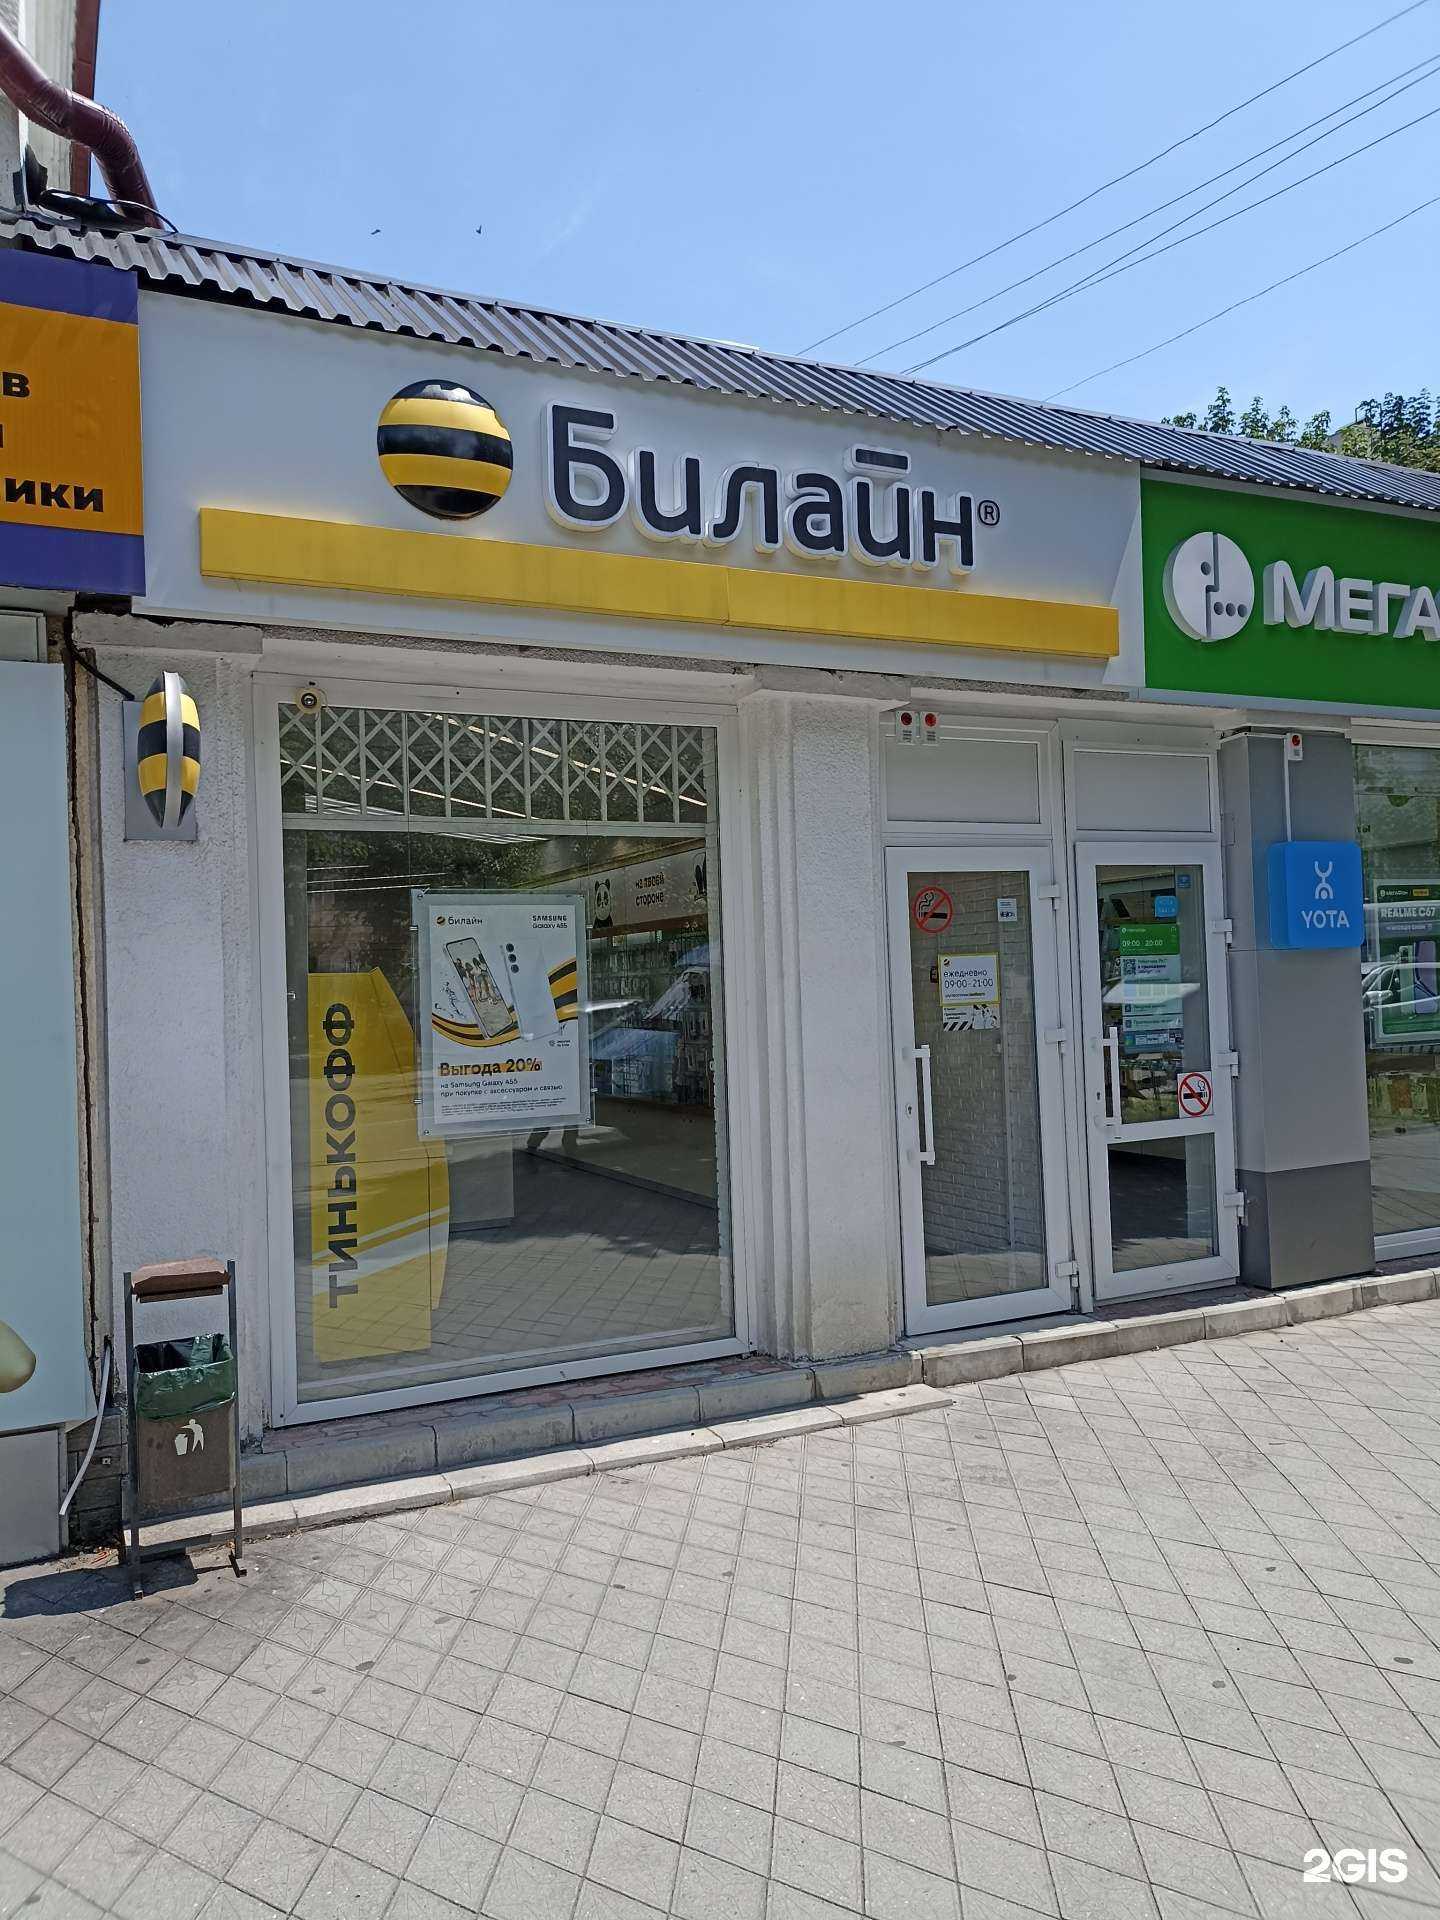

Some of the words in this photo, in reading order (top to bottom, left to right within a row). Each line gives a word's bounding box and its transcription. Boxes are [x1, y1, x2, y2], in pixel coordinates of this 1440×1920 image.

[1263, 560, 1440, 642] МЕГА
[532, 914, 567, 922] SAMSUNG
[1301, 909, 1350, 929] YOTA
[1381, 907, 1417, 918] REALME
[943, 969, 988, 978] ежедневно
[440, 1061, 502, 1077] Выгода
[506, 1057, 541, 1073] 20%
[450, 1081, 481, 1089] Samsung
[482, 1079, 503, 1087] Galaxy
[322, 1003, 359, 1309] ТИНЬКОФФ
